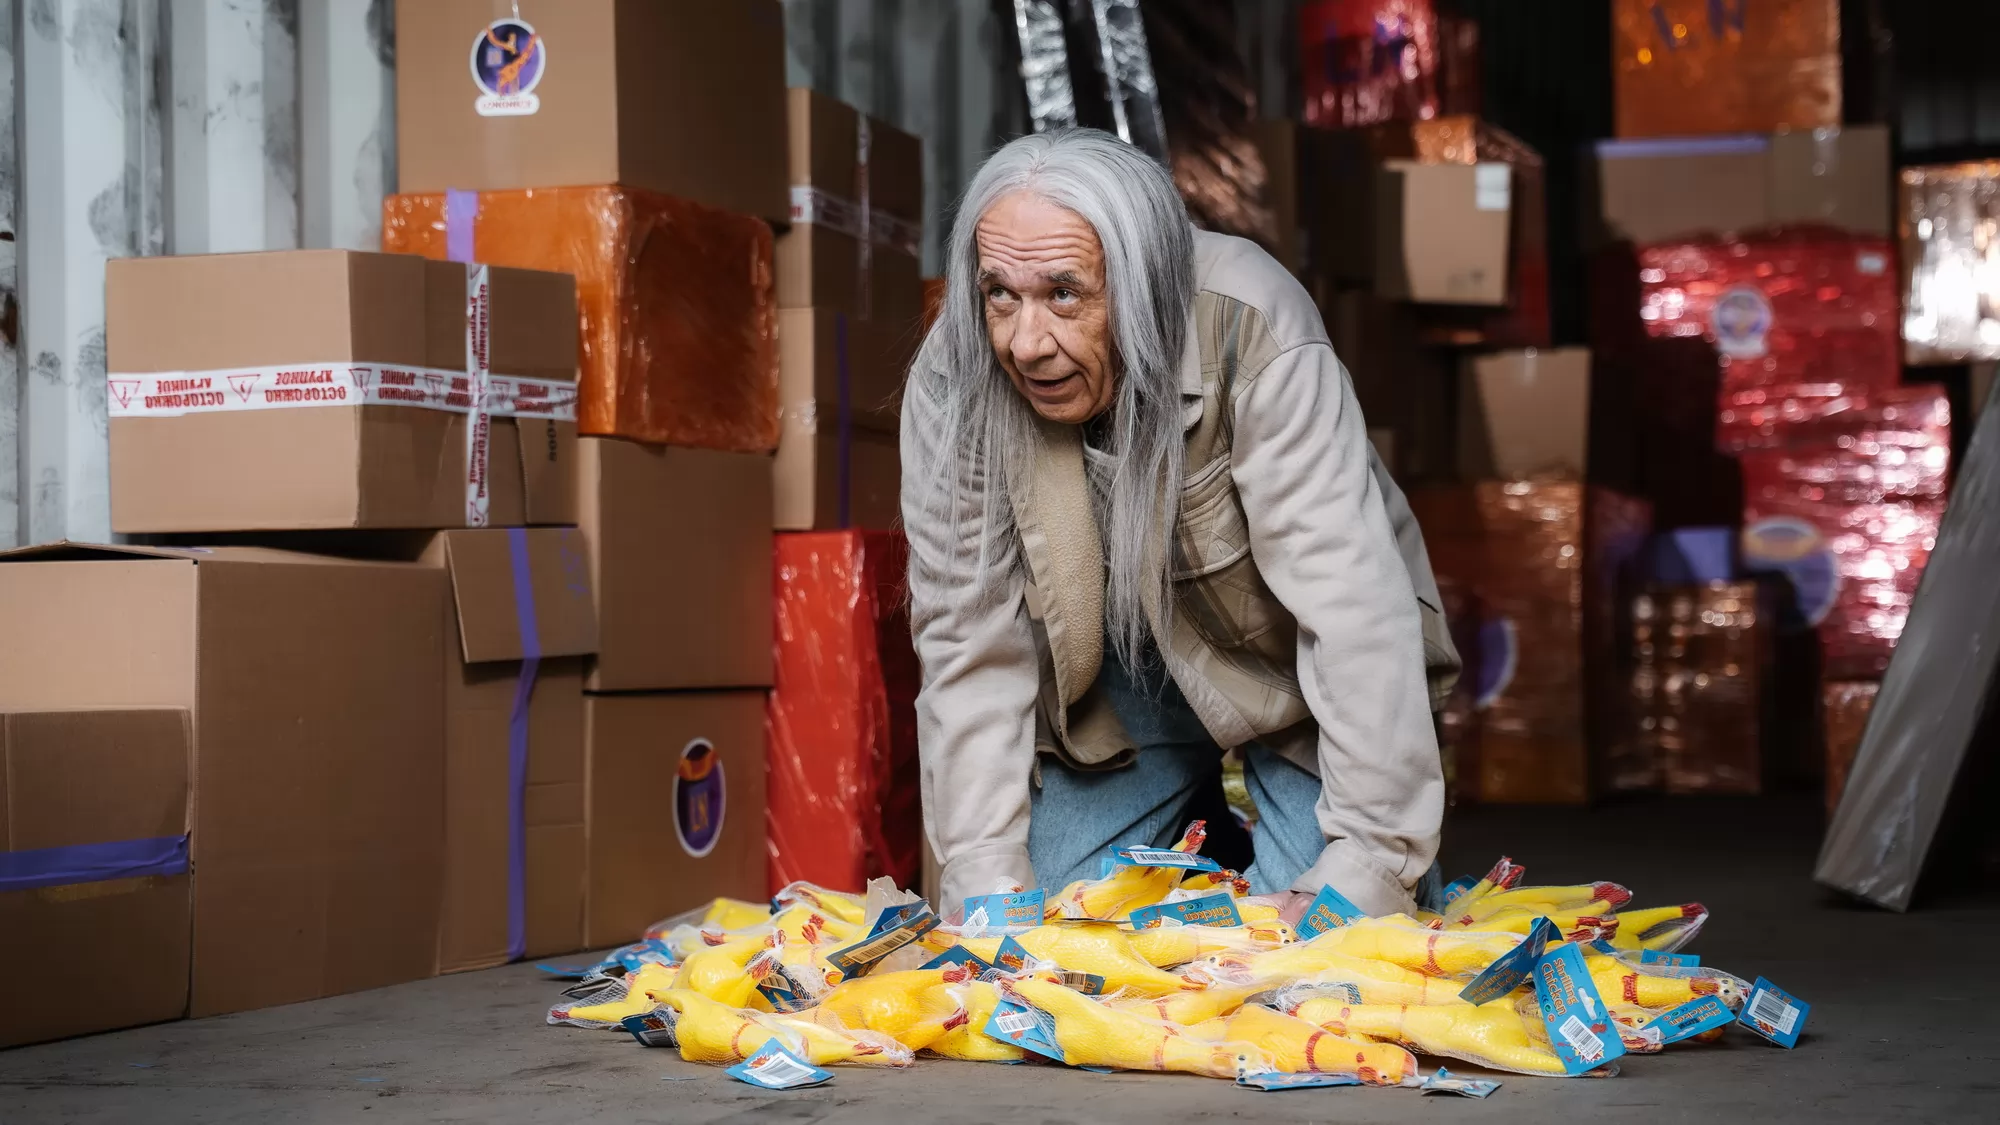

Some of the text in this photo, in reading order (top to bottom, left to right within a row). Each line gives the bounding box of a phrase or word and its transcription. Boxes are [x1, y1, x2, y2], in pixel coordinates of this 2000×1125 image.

[275, 369, 333, 385] ХРУПКОЕ
[144, 391, 225, 409] ОСТОРОЖНО
[265, 385, 347, 403] ОСТОРОЖНО
[1004, 903, 1039, 918] Chicken
[1184, 905, 1232, 921] Chicken
[1309, 914, 1330, 932] Chic
[1469, 968, 1512, 996] Shrilling
[1473, 971, 1518, 1001] Chicken
[1541, 962, 1567, 1016] Chicken
[1554, 957, 1579, 1007] Shrilling
[1669, 1001, 1717, 1026] Chicken
